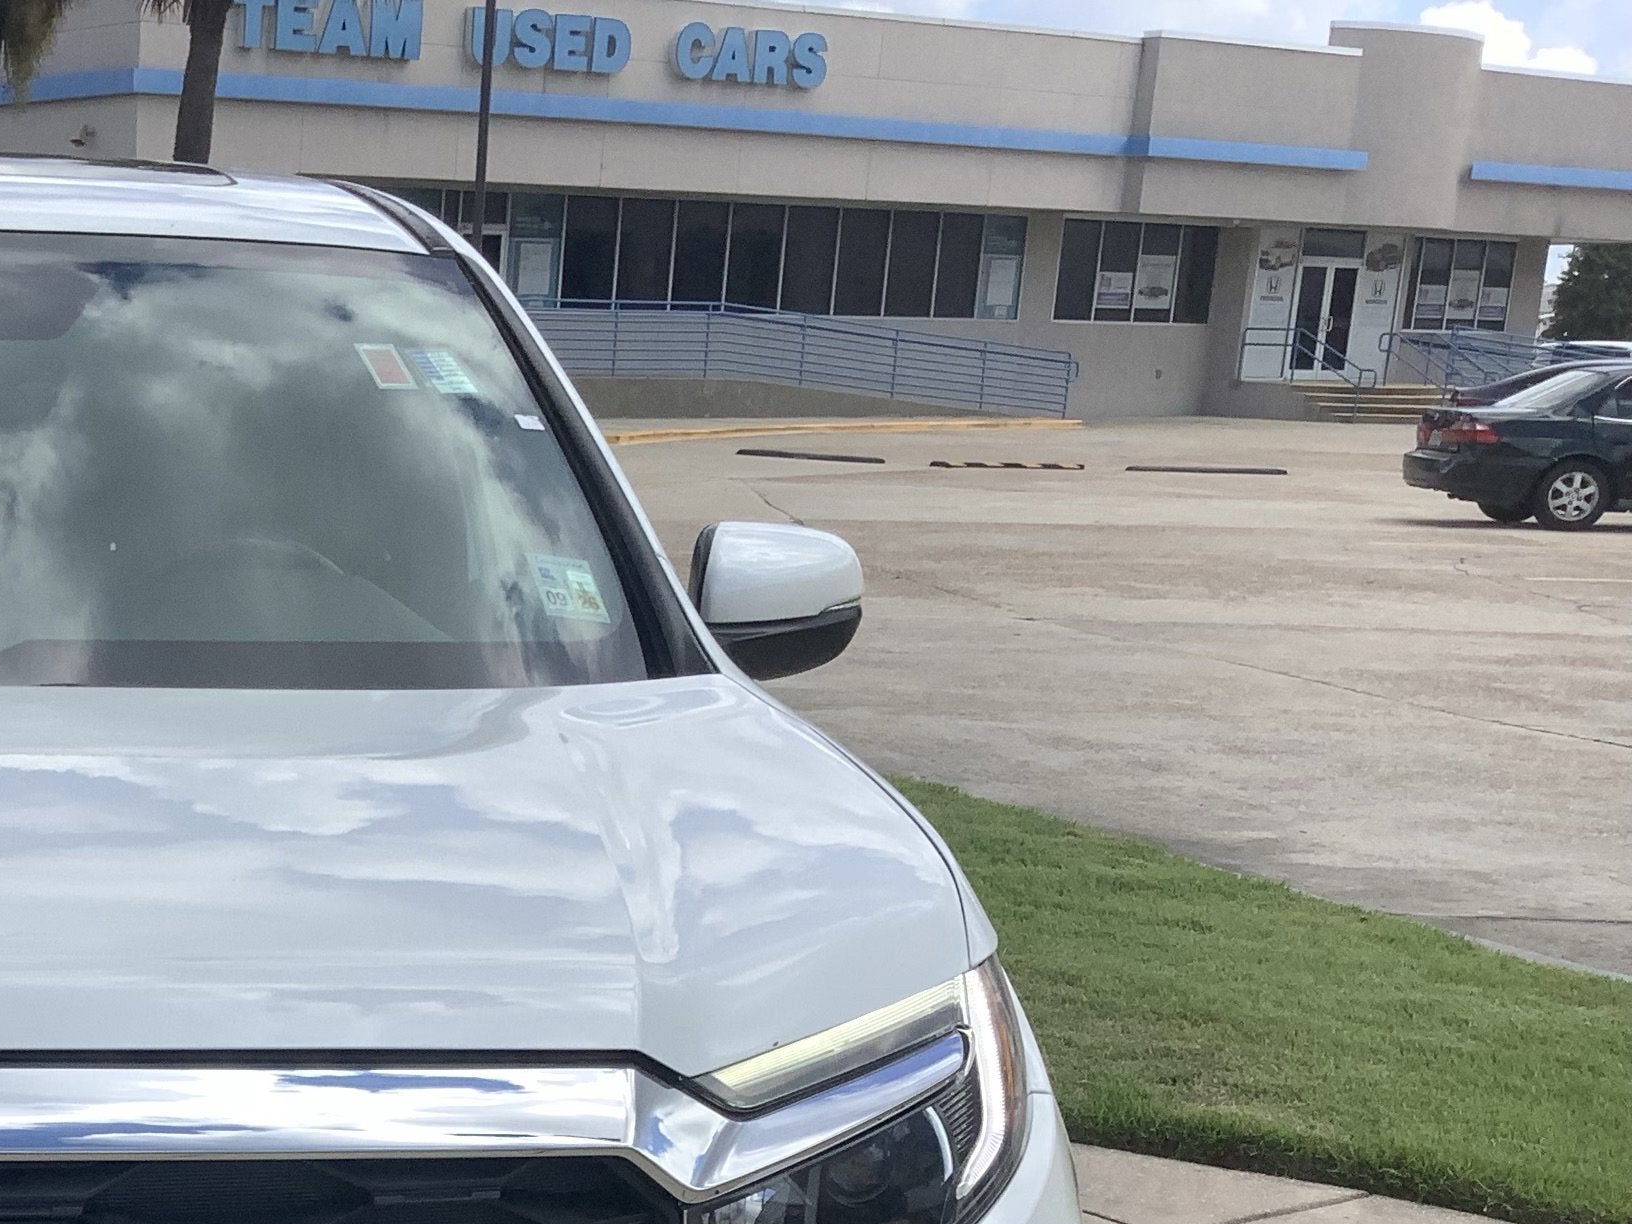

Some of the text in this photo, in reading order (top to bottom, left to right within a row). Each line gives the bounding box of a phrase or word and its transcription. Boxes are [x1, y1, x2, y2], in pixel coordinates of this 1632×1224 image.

[236, 0, 828, 90] TEAM USED CARS
[546, 590, 568, 606] 09
